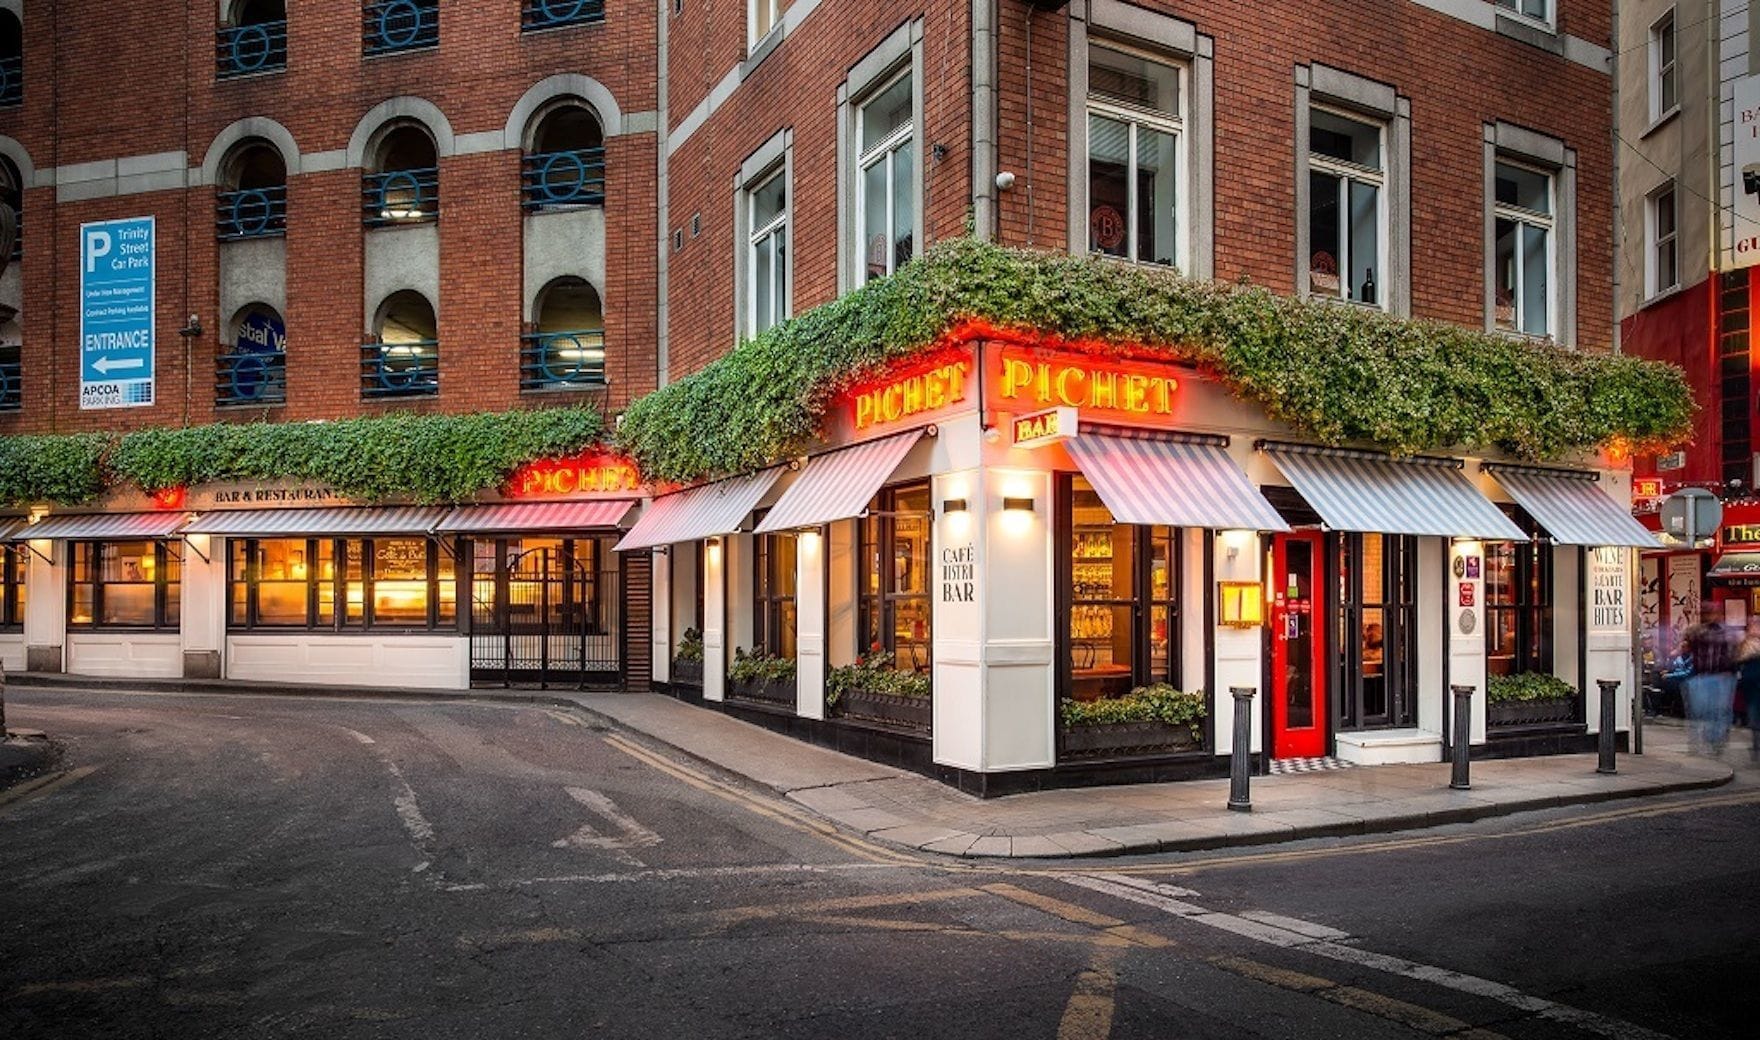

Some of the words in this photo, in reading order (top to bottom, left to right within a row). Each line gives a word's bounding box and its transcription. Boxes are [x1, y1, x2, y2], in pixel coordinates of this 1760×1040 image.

[118, 226, 149, 241] Trinity
[87, 230, 111, 273] P
[119, 242, 149, 256] Street
[111, 257, 126, 271] Car
[128, 255, 149, 269] Park
[85, 328, 149, 352] ENTRANCE
[82, 384, 120, 396] APCOA
[855, 361, 967, 429] PICHET
[1002, 357, 1178, 415] PICHET
[82, 395, 120, 407] PARKING
[1016, 410, 1060, 443] BAR
[215, 490, 240, 502] BAR
[242, 490, 252, 502] &
[255, 487, 339, 501] RESTAURAN
[943, 542, 974, 563] CAFÉ
[943, 582, 975, 602] BAR
[1594, 589, 1623, 605] BAR
[1594, 607, 1624, 626] BITES
